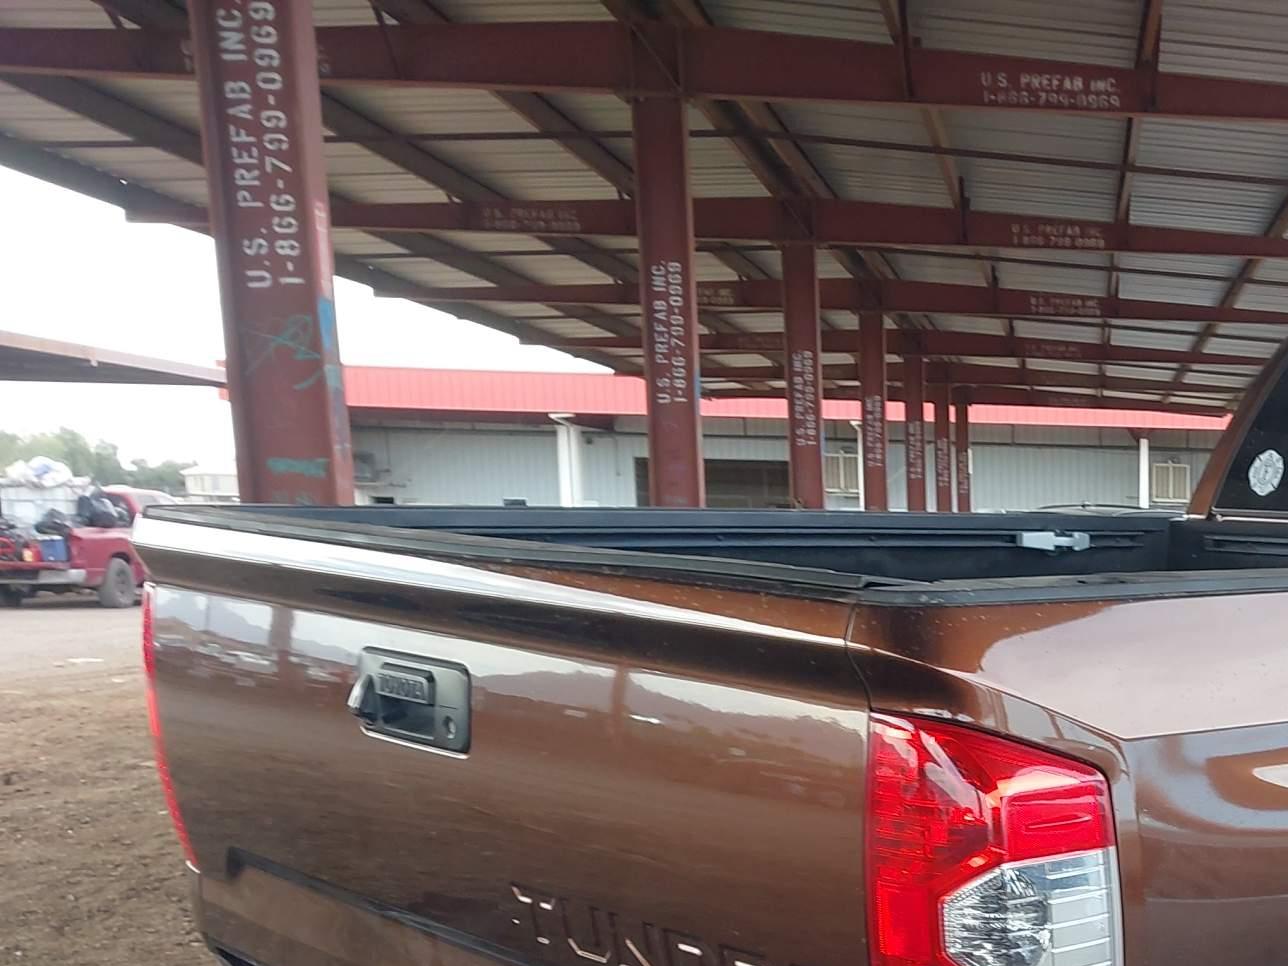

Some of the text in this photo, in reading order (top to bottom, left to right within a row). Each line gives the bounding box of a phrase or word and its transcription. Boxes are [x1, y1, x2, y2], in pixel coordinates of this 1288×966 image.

[1020, 73, 1083, 91] PREFAB
[224, 81, 264, 207] PREFAB
[249, 1, 306, 284] 1-866-799-0969
[243, 227, 272, 288] U.S.
[652, 300, 670, 364] PREFAB
[667, 261, 688, 403] 1-866-799-0969
[656, 373, 672, 404] U.S.
